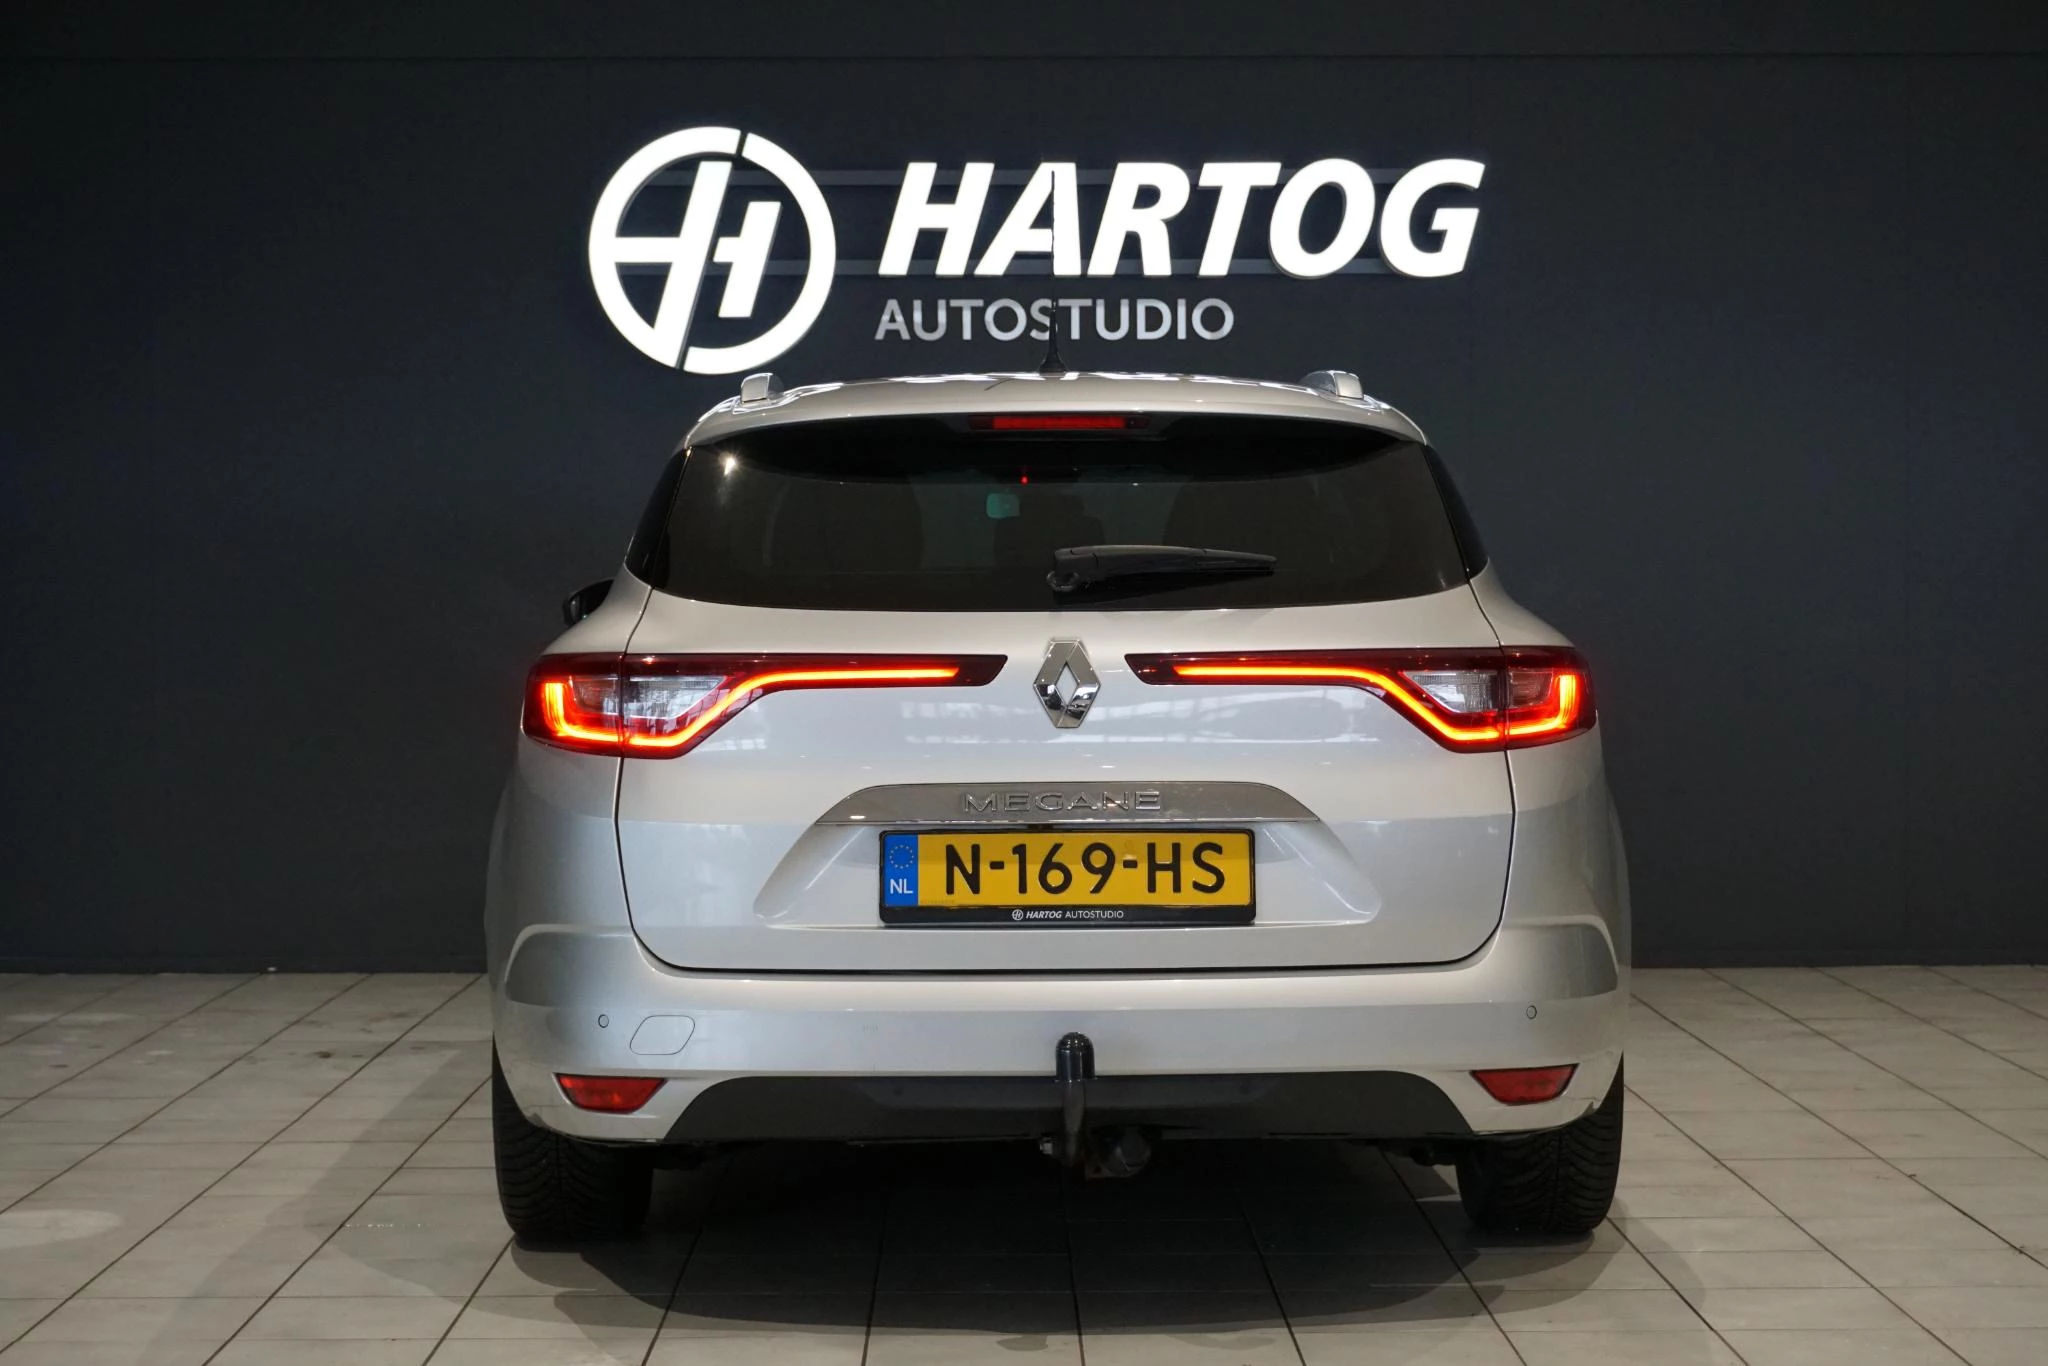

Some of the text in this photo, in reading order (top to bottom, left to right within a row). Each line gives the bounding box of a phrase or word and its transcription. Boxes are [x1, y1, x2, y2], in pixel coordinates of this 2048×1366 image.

[878, 157, 1486, 279] HARTOG
[874, 297, 1235, 341] AUTOSTUDIO
[964, 791, 1161, 812] MEGANE
[945, 842, 1225, 895] N-169-HS
[889, 879, 913, 894] NL
[1025, 910, 1062, 919] HARTOG
[1065, 910, 1124, 919] AUTOSTUDIO
